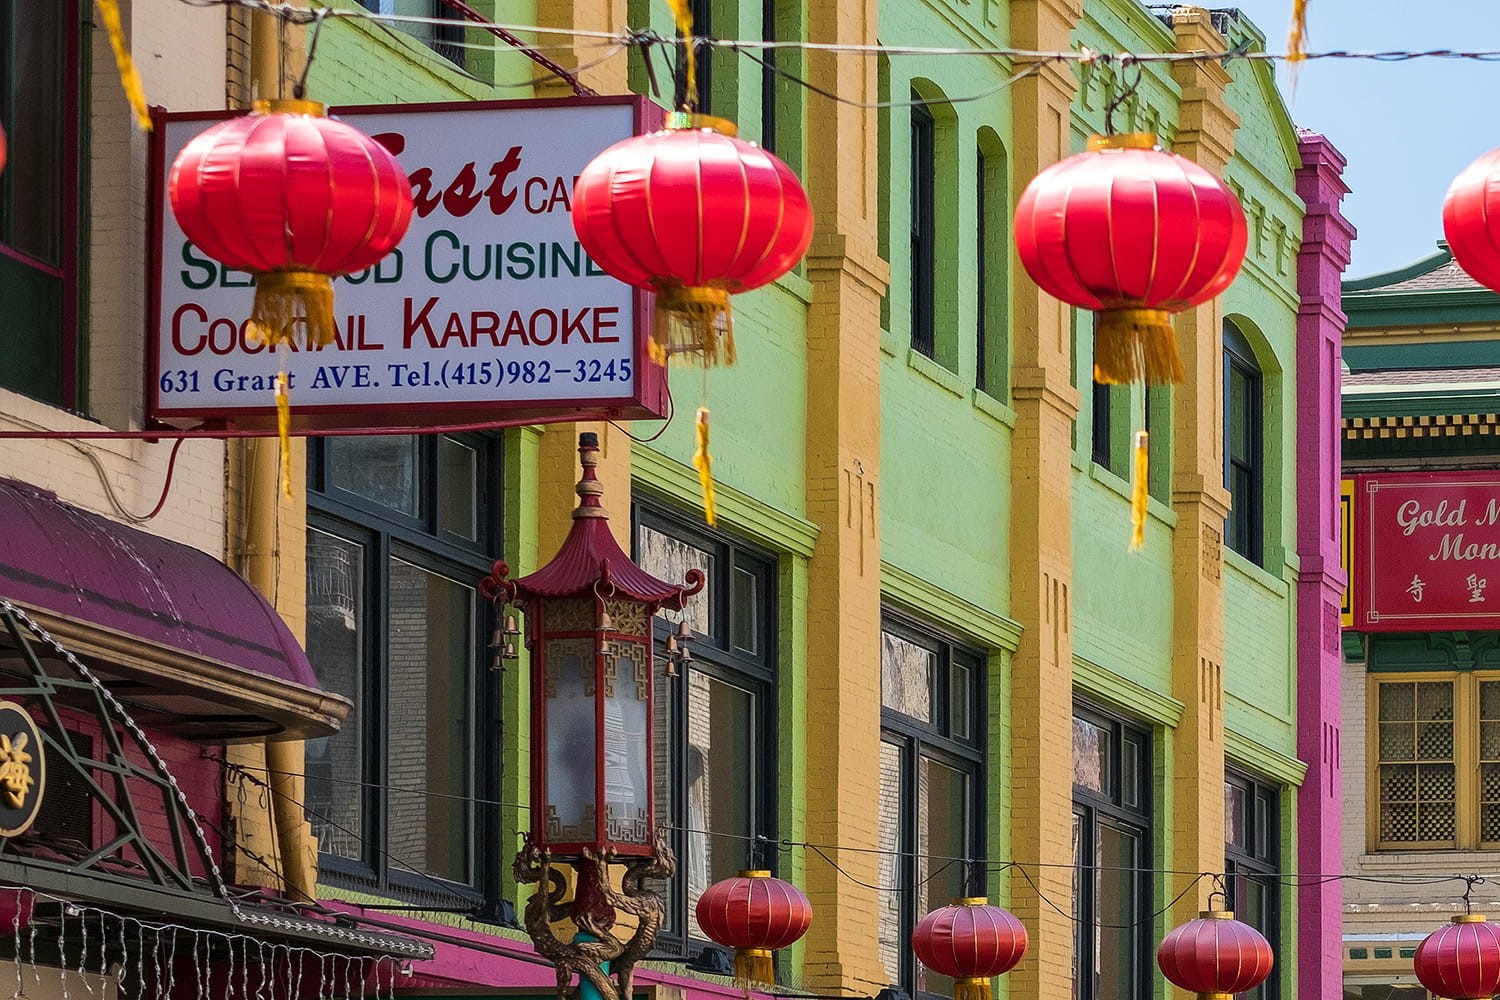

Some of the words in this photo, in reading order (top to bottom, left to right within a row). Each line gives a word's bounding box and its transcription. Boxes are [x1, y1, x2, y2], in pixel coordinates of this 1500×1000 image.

[371, 132, 523, 218] ast
[525, 175, 580, 214] CA
[403, 297, 620, 350] KARAOKE
[159, 370, 201, 392] 631
[311, 364, 380, 388] AVE.
[1397, 499, 1469, 537] Gold
